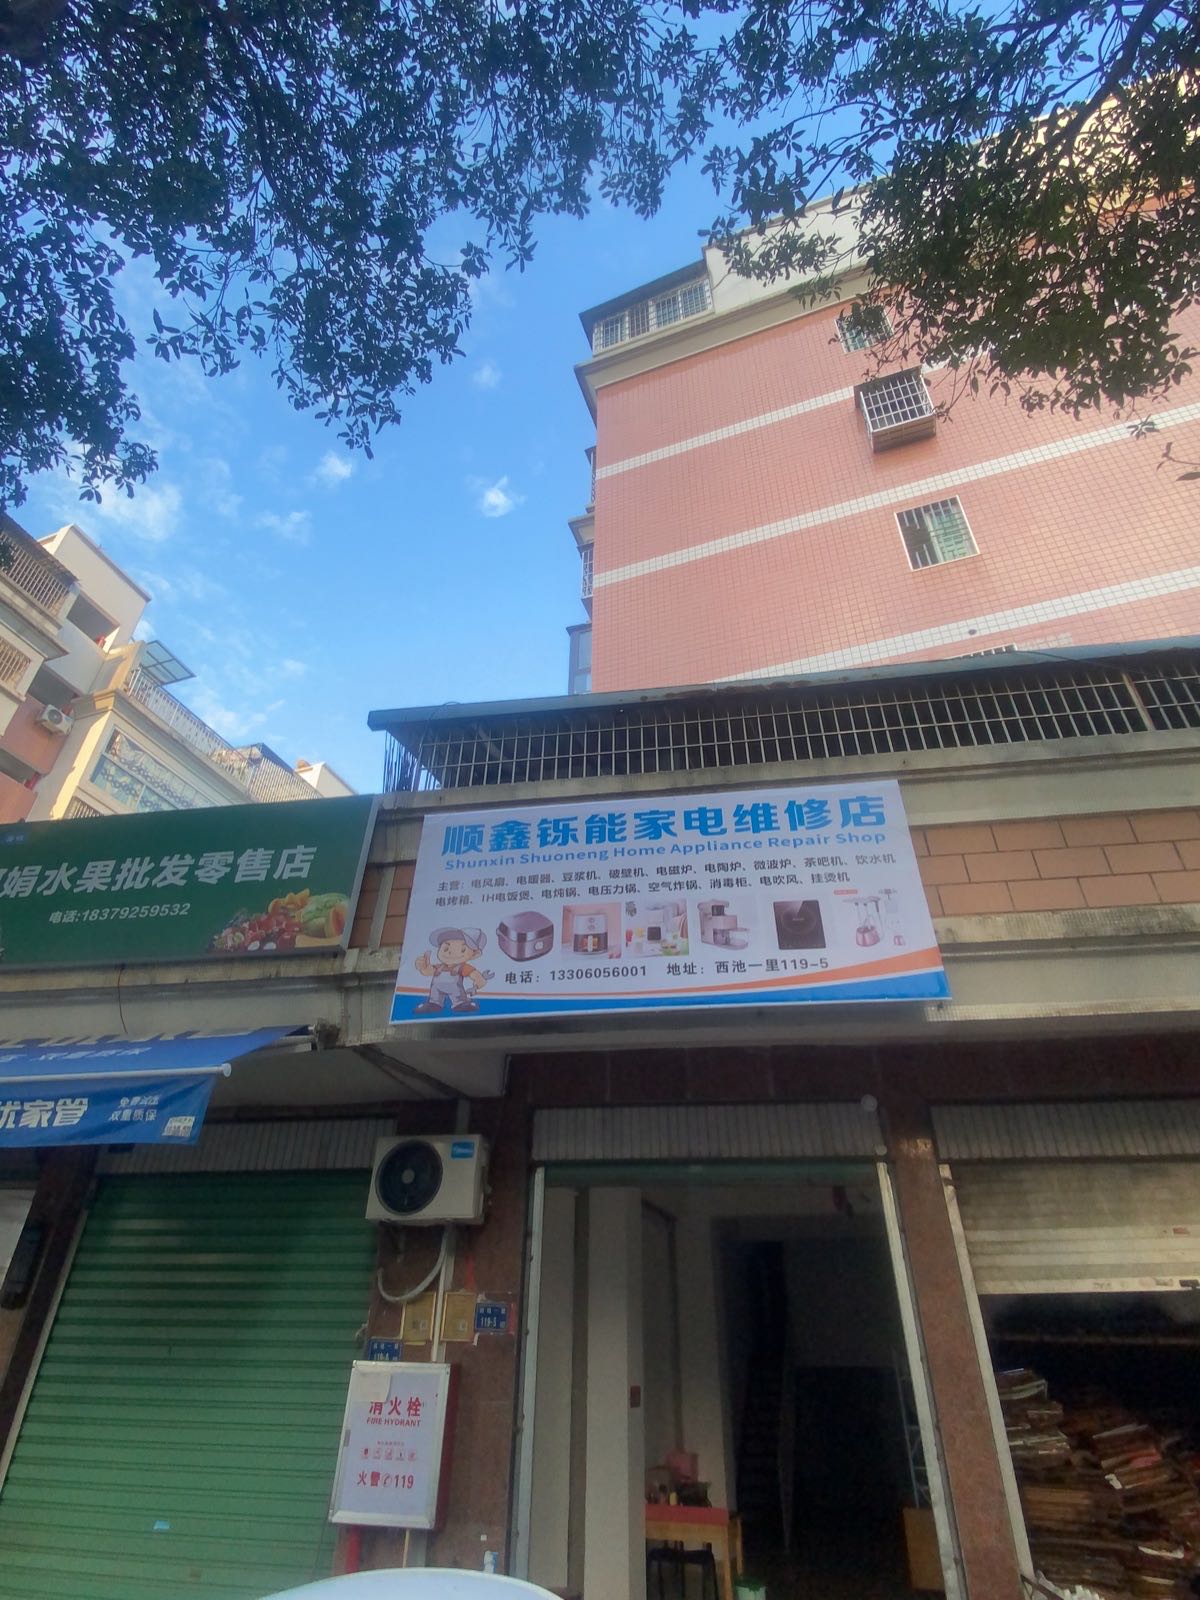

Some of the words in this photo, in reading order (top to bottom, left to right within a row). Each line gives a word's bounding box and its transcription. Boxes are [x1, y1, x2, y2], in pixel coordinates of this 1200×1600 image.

[441, 796, 886, 856] 顺鑫铄能家电维修店
[444, 853, 515, 871] Shunxin
[519, 849, 609, 864] Shuoneng
[613, 845, 666, 858] Home
[670, 838, 762, 855] Appliance
[768, 834, 831, 850] Repair
[835, 831, 886, 846] Shop
[0, 845, 317, 899] 娟水果批发零售店
[366, 1416, 383, 1425] FIRE
[384, 1418, 421, 1427] HYDRANT
[368, 1396, 423, 1418] 消火栓
[394, 1474, 414, 1489] 119
